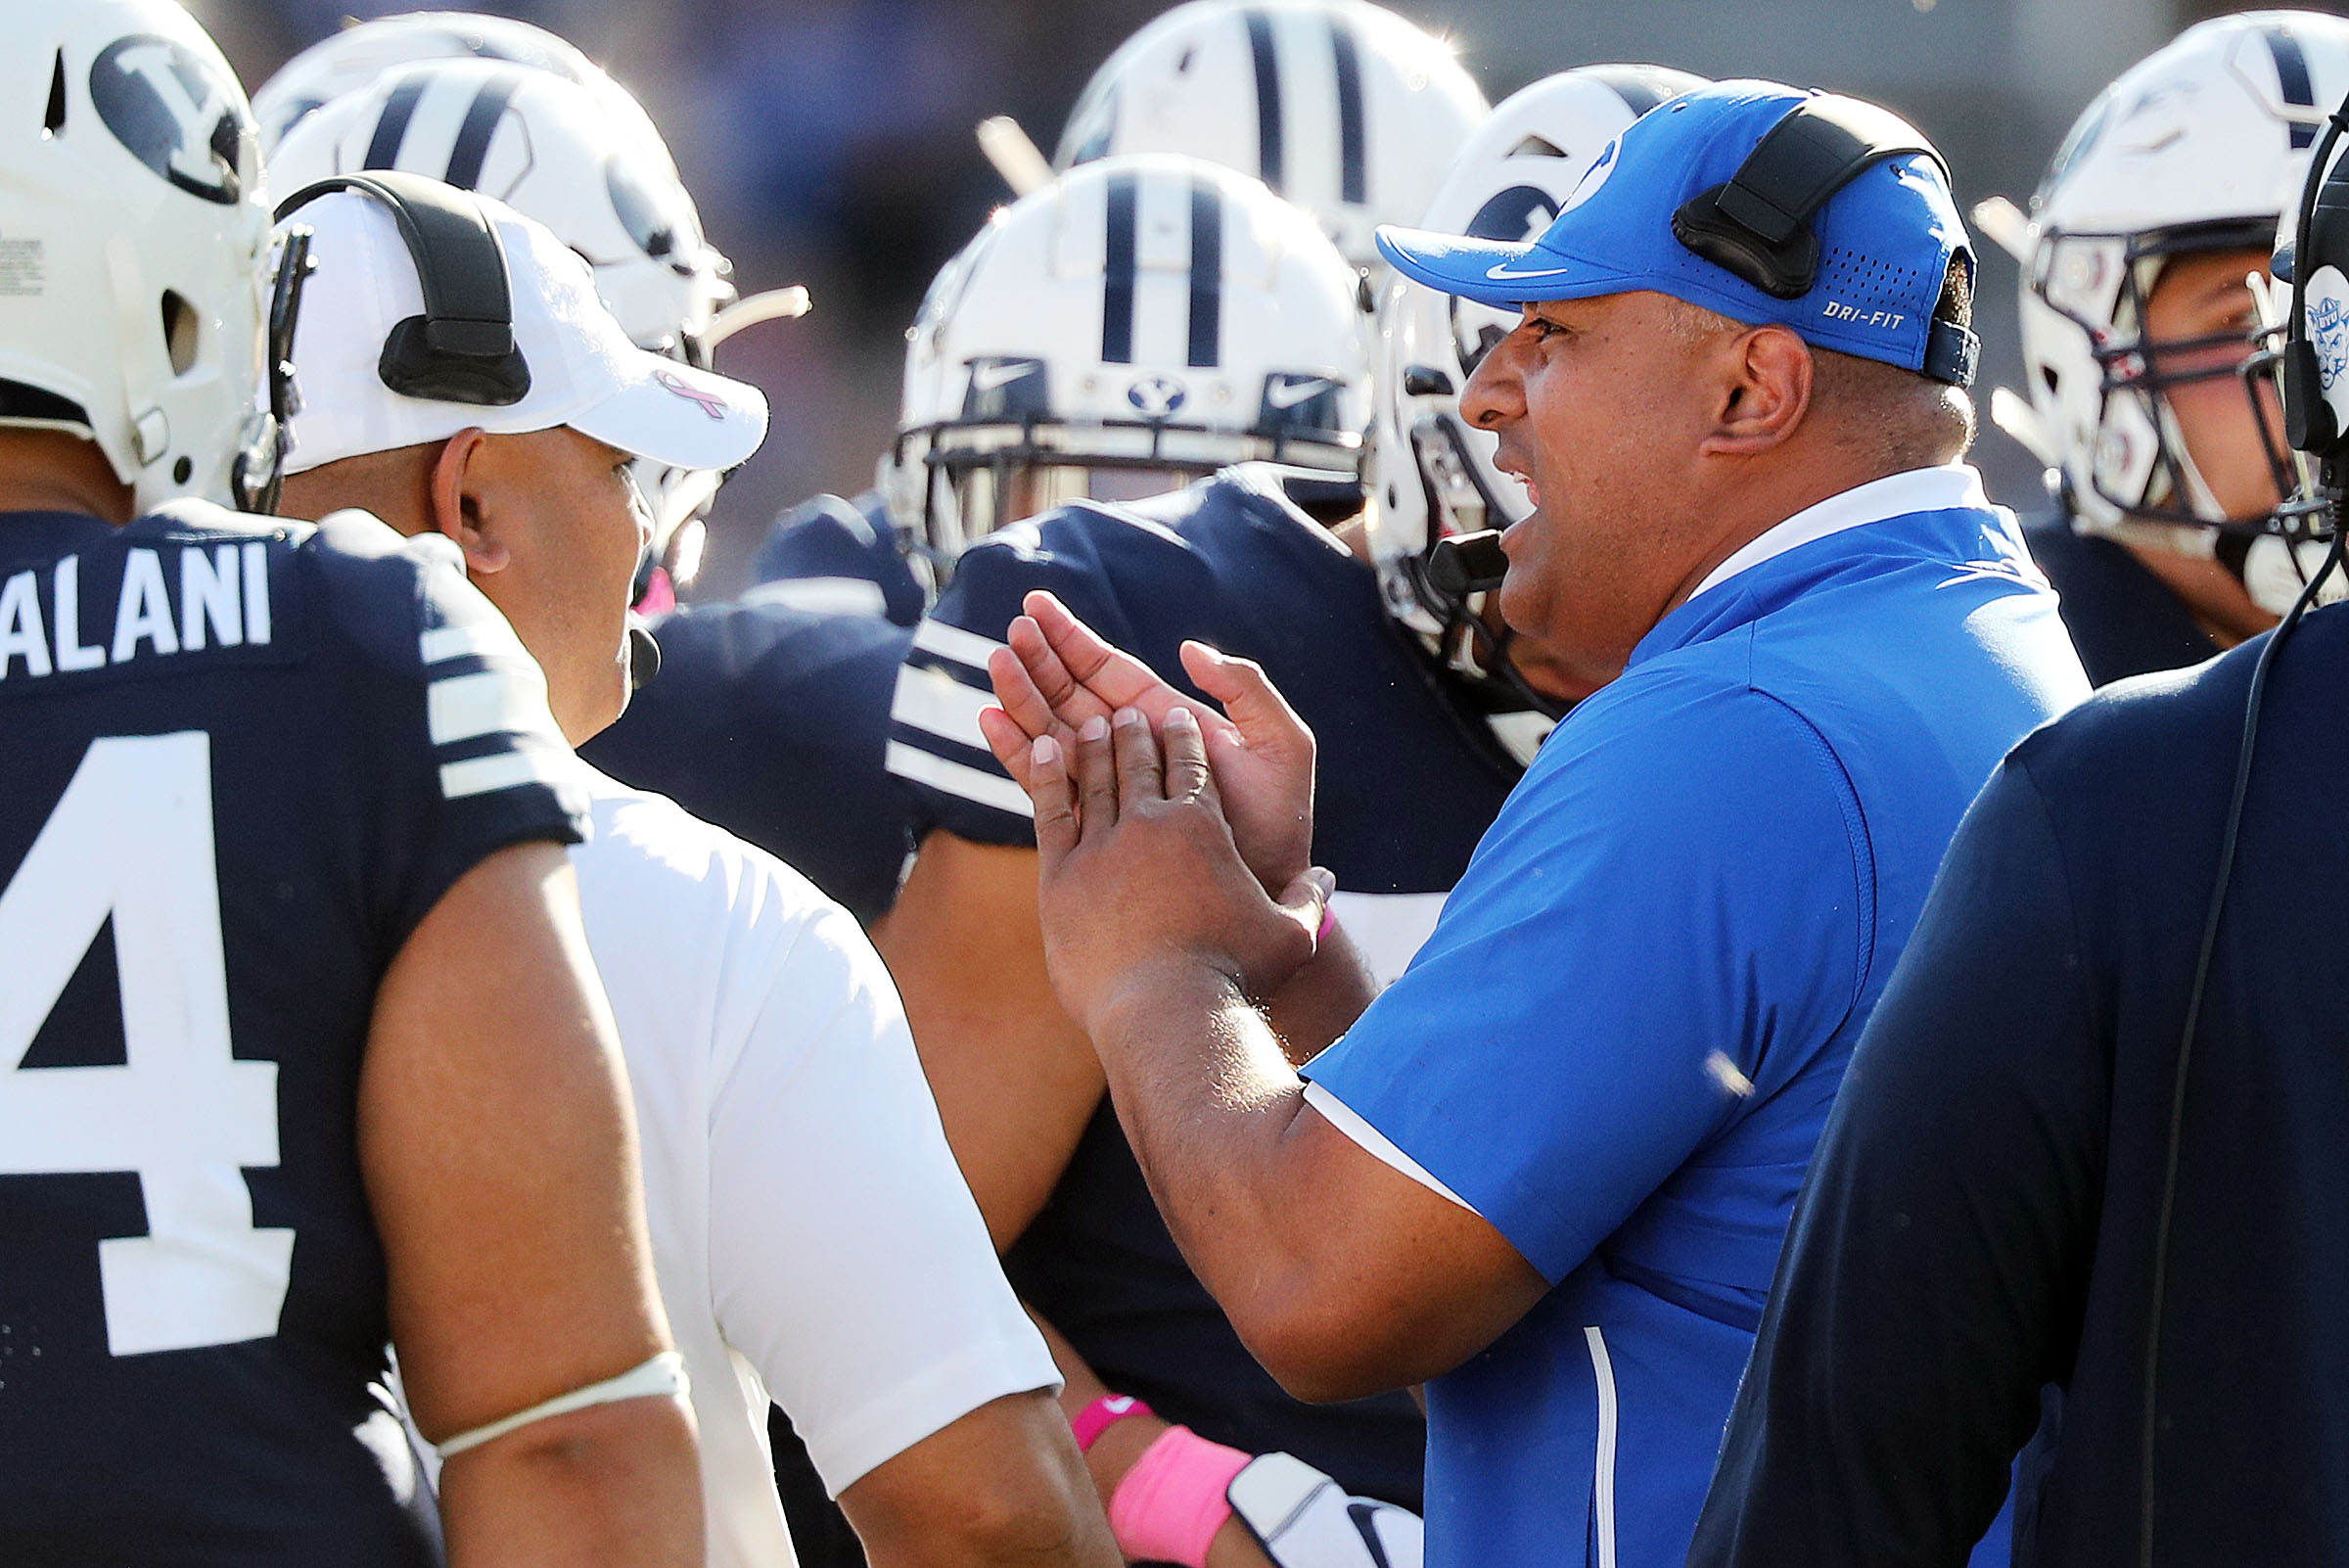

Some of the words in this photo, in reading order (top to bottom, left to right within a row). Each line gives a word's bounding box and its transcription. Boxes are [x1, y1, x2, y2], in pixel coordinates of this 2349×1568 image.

[1822, 300, 1905, 330] DRI-FIT
[2319, 311, 2338, 330] BYU
[0, 541, 272, 681] ALANI
[0, 729, 297, 1358] 4
